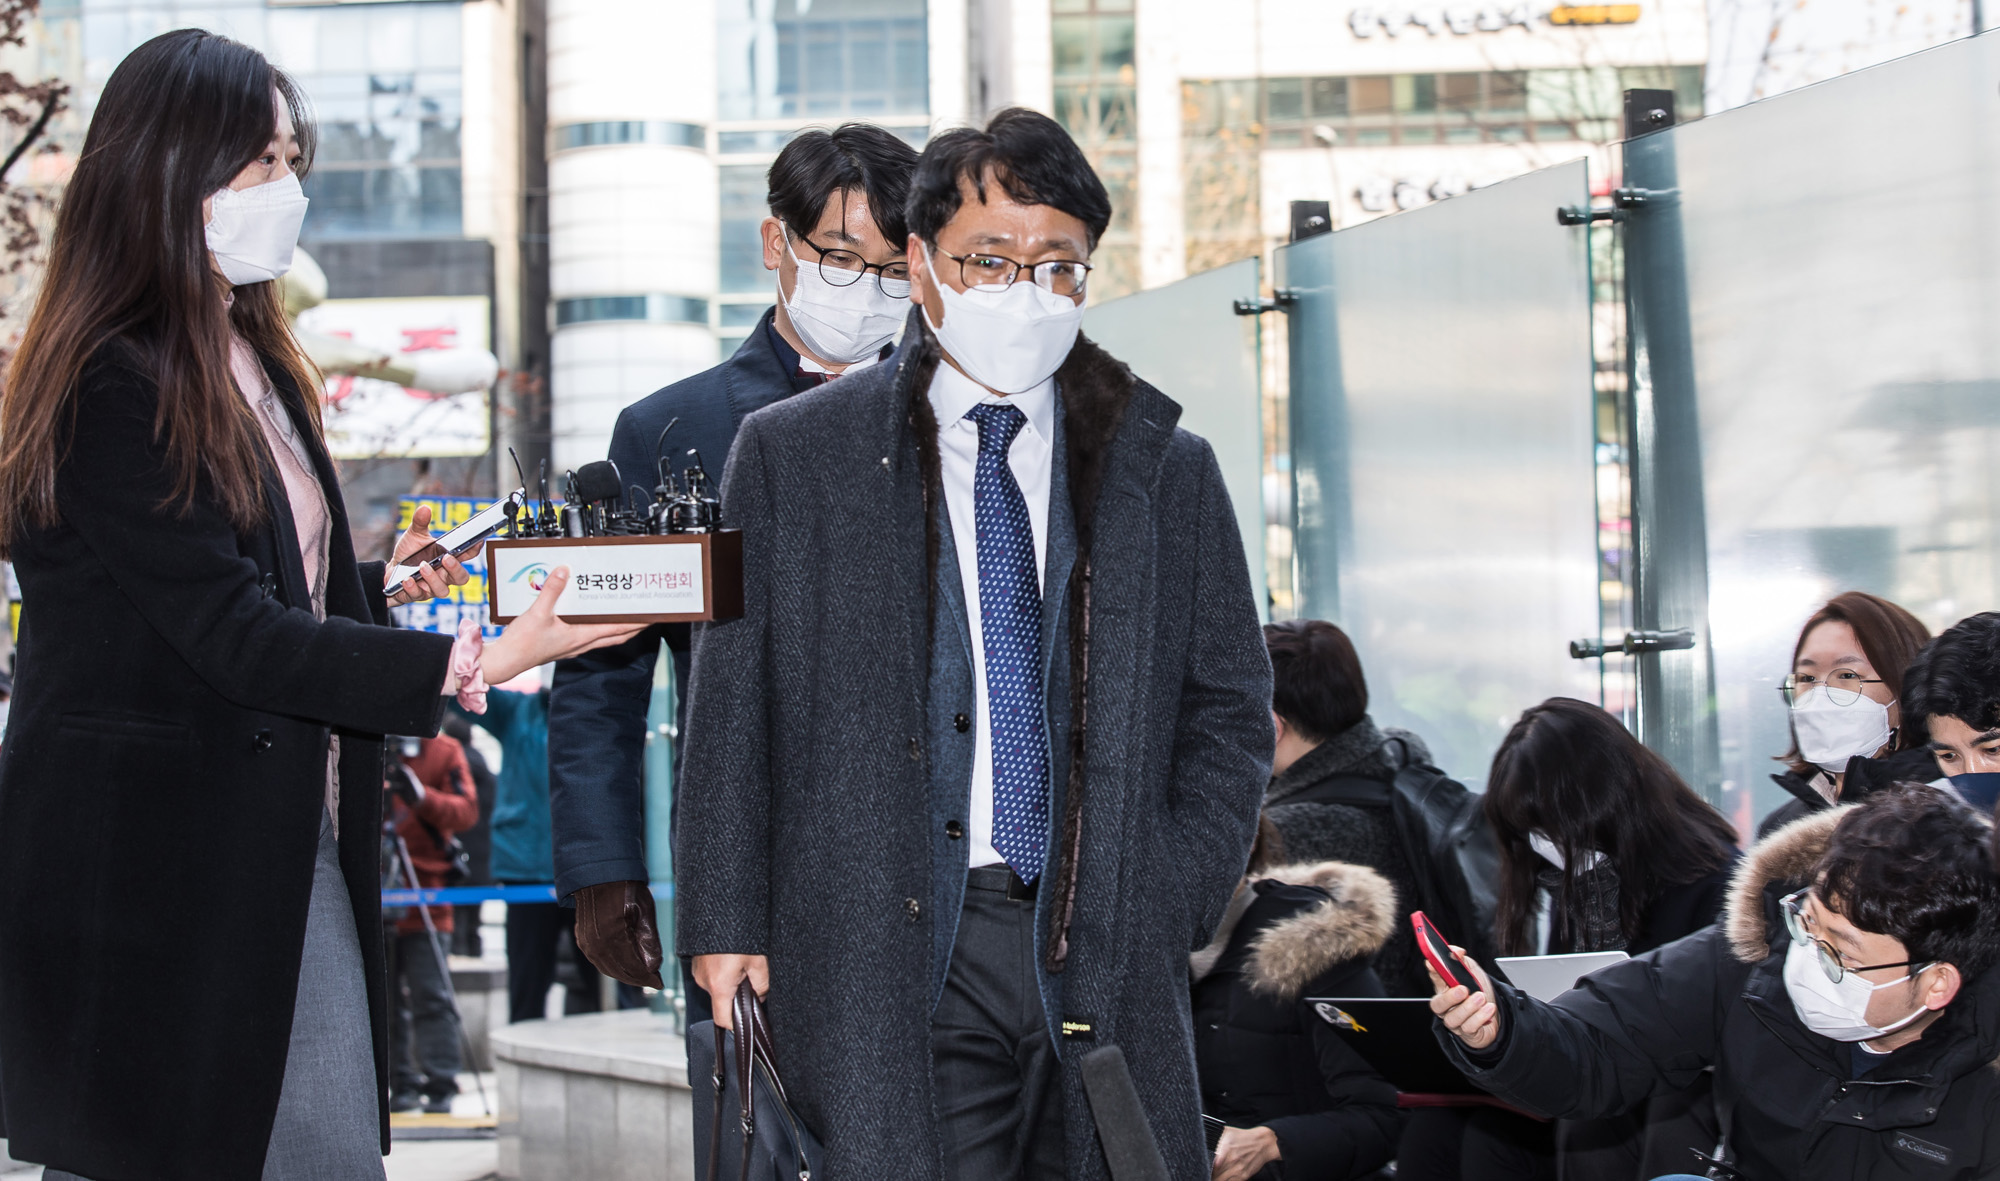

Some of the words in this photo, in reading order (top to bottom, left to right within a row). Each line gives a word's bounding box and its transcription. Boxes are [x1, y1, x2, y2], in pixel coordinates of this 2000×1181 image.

[576, 571, 693, 591] 한국영상기자협회
[578, 593, 598, 601] Korea
[599, 592, 618, 600] Video
[653, 591, 694, 599] Association
[1907, 1140, 1947, 1161] Columbia
